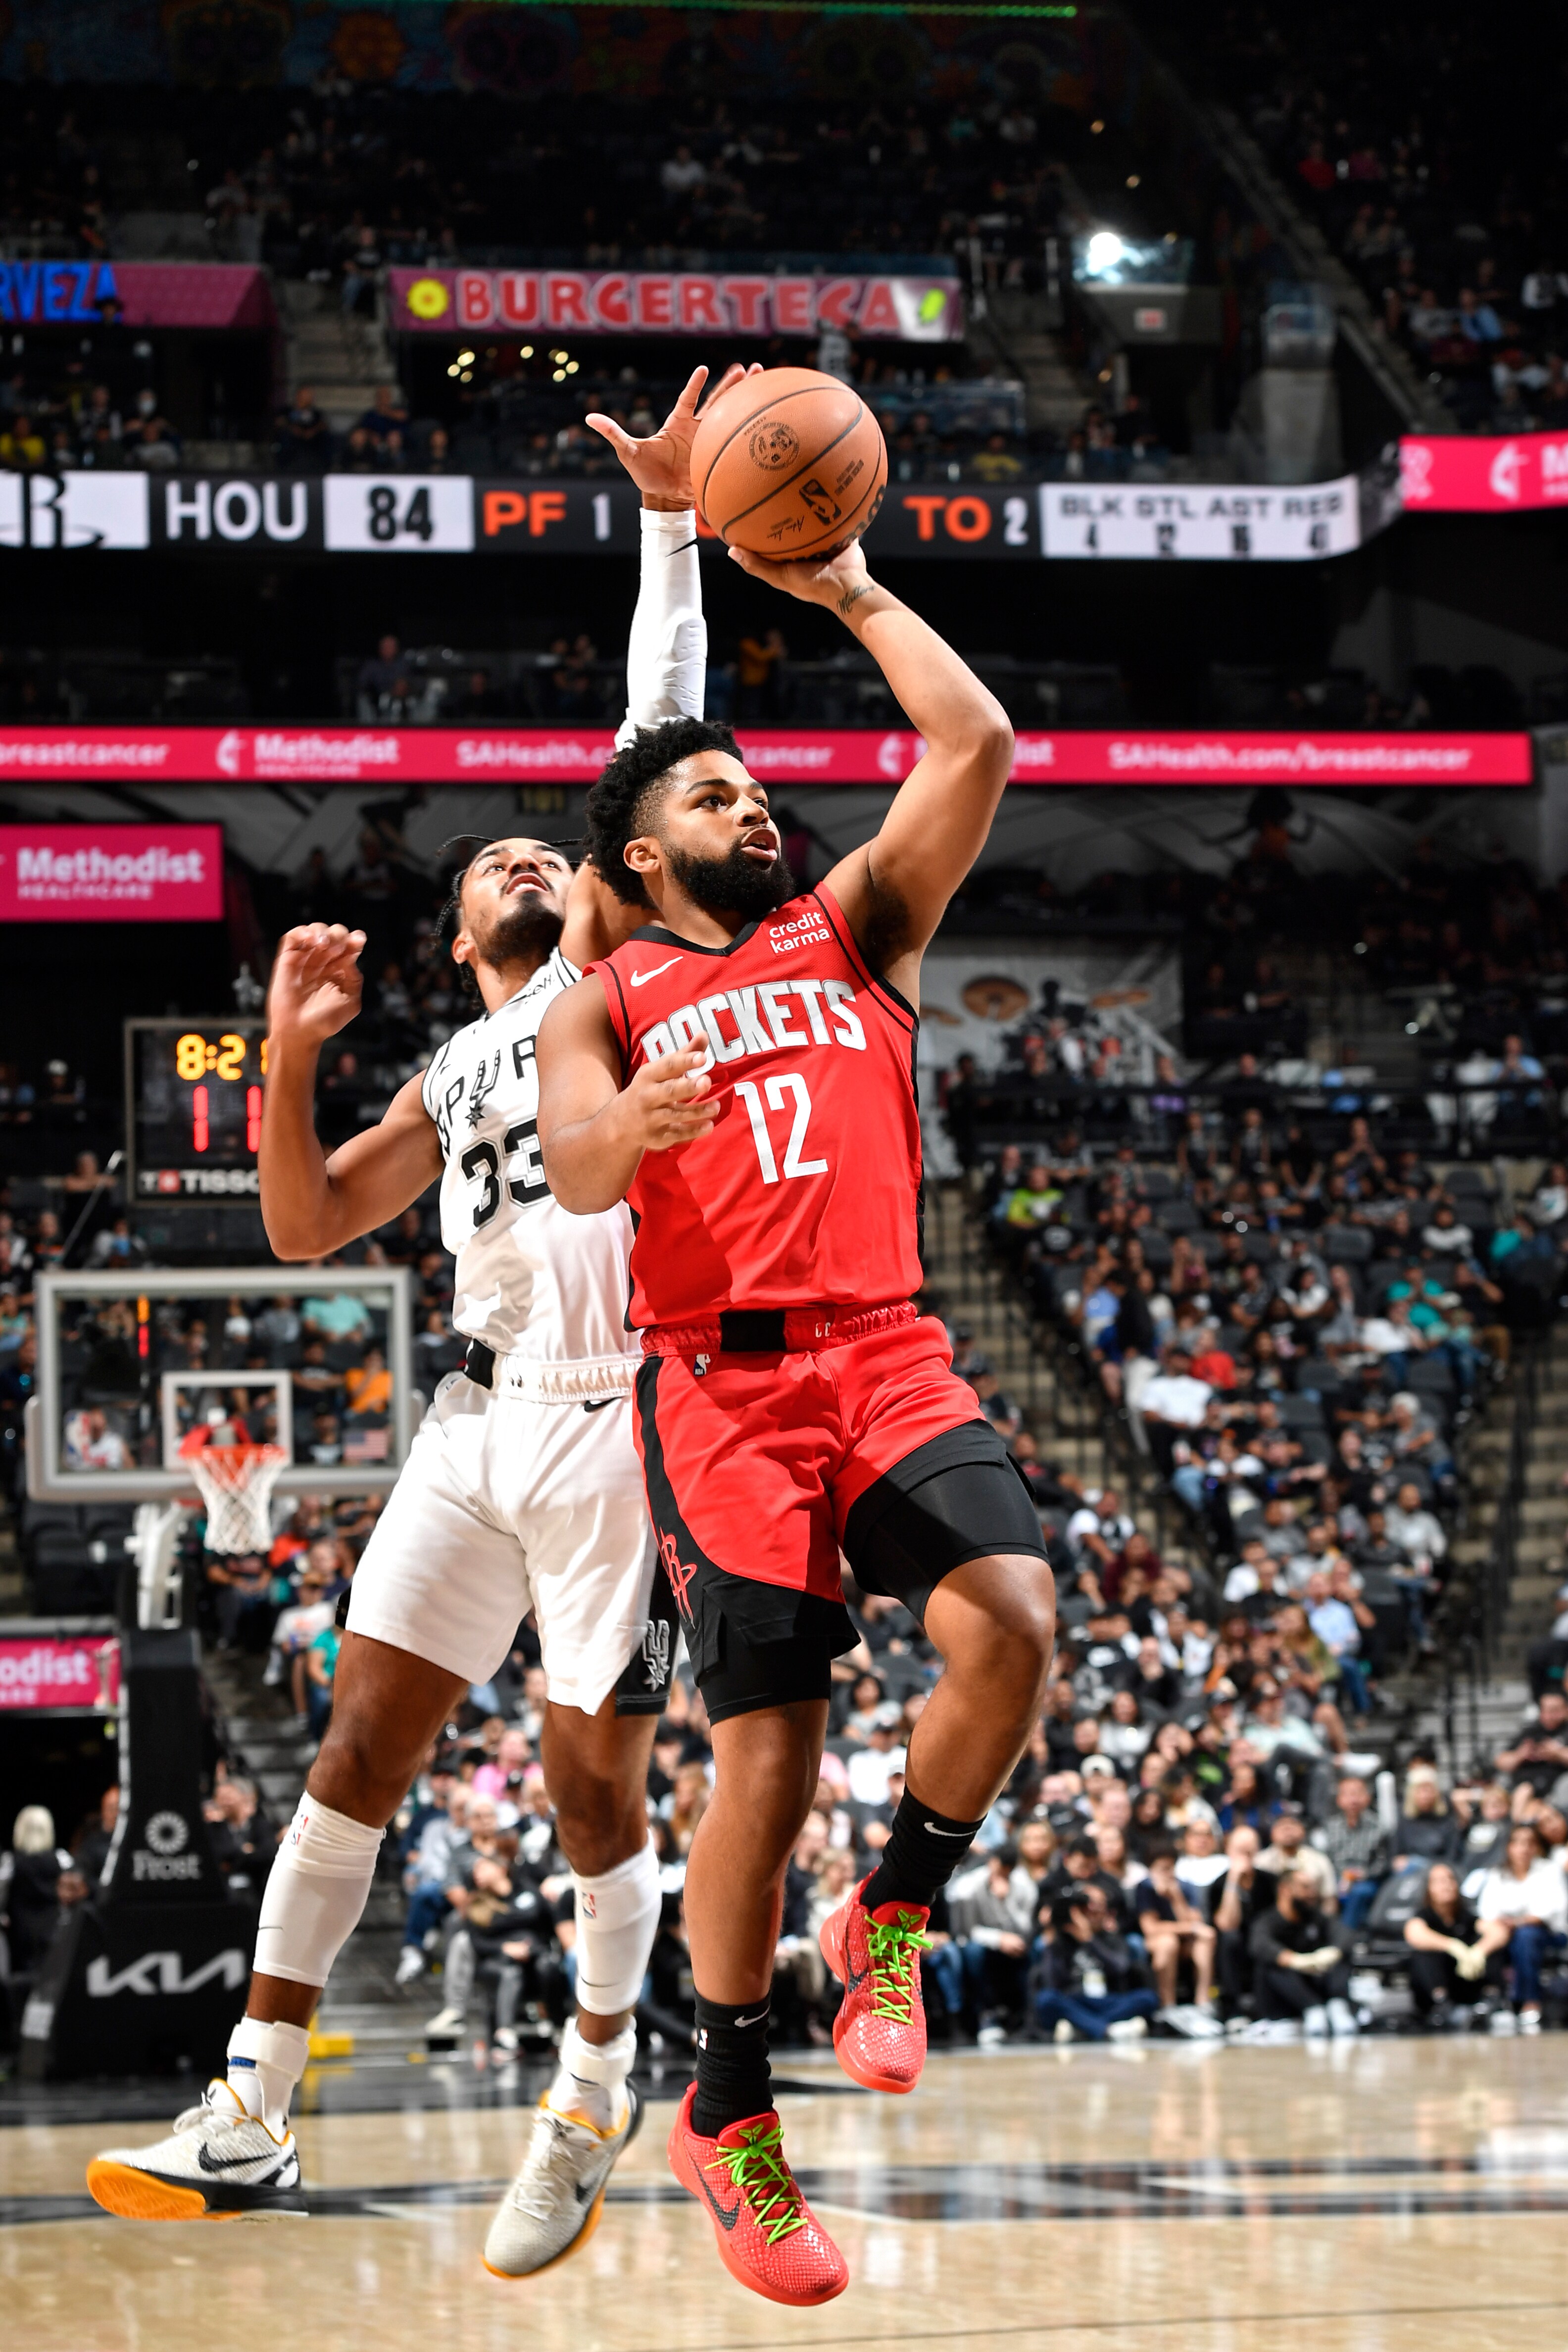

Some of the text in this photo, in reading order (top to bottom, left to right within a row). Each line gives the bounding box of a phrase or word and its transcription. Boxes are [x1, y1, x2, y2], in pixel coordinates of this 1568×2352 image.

[456, 270, 901, 334] BURGERTECA
[165, 480, 308, 541] HOU
[367, 485, 434, 541] 84
[483, 491, 611, 540] PF 1
[903, 495, 991, 541] TO
[1003, 497, 1029, 545] 2
[255, 734, 399, 763] Methodist
[17, 846, 205, 882] Methodist
[769, 912, 824, 938] credit
[770, 929, 830, 953] karma
[640, 980, 866, 1078] ROCKETS
[735, 1073, 828, 1184] 12
[459, 1118, 555, 1228] 33
[133, 1850, 200, 1880] Frost
